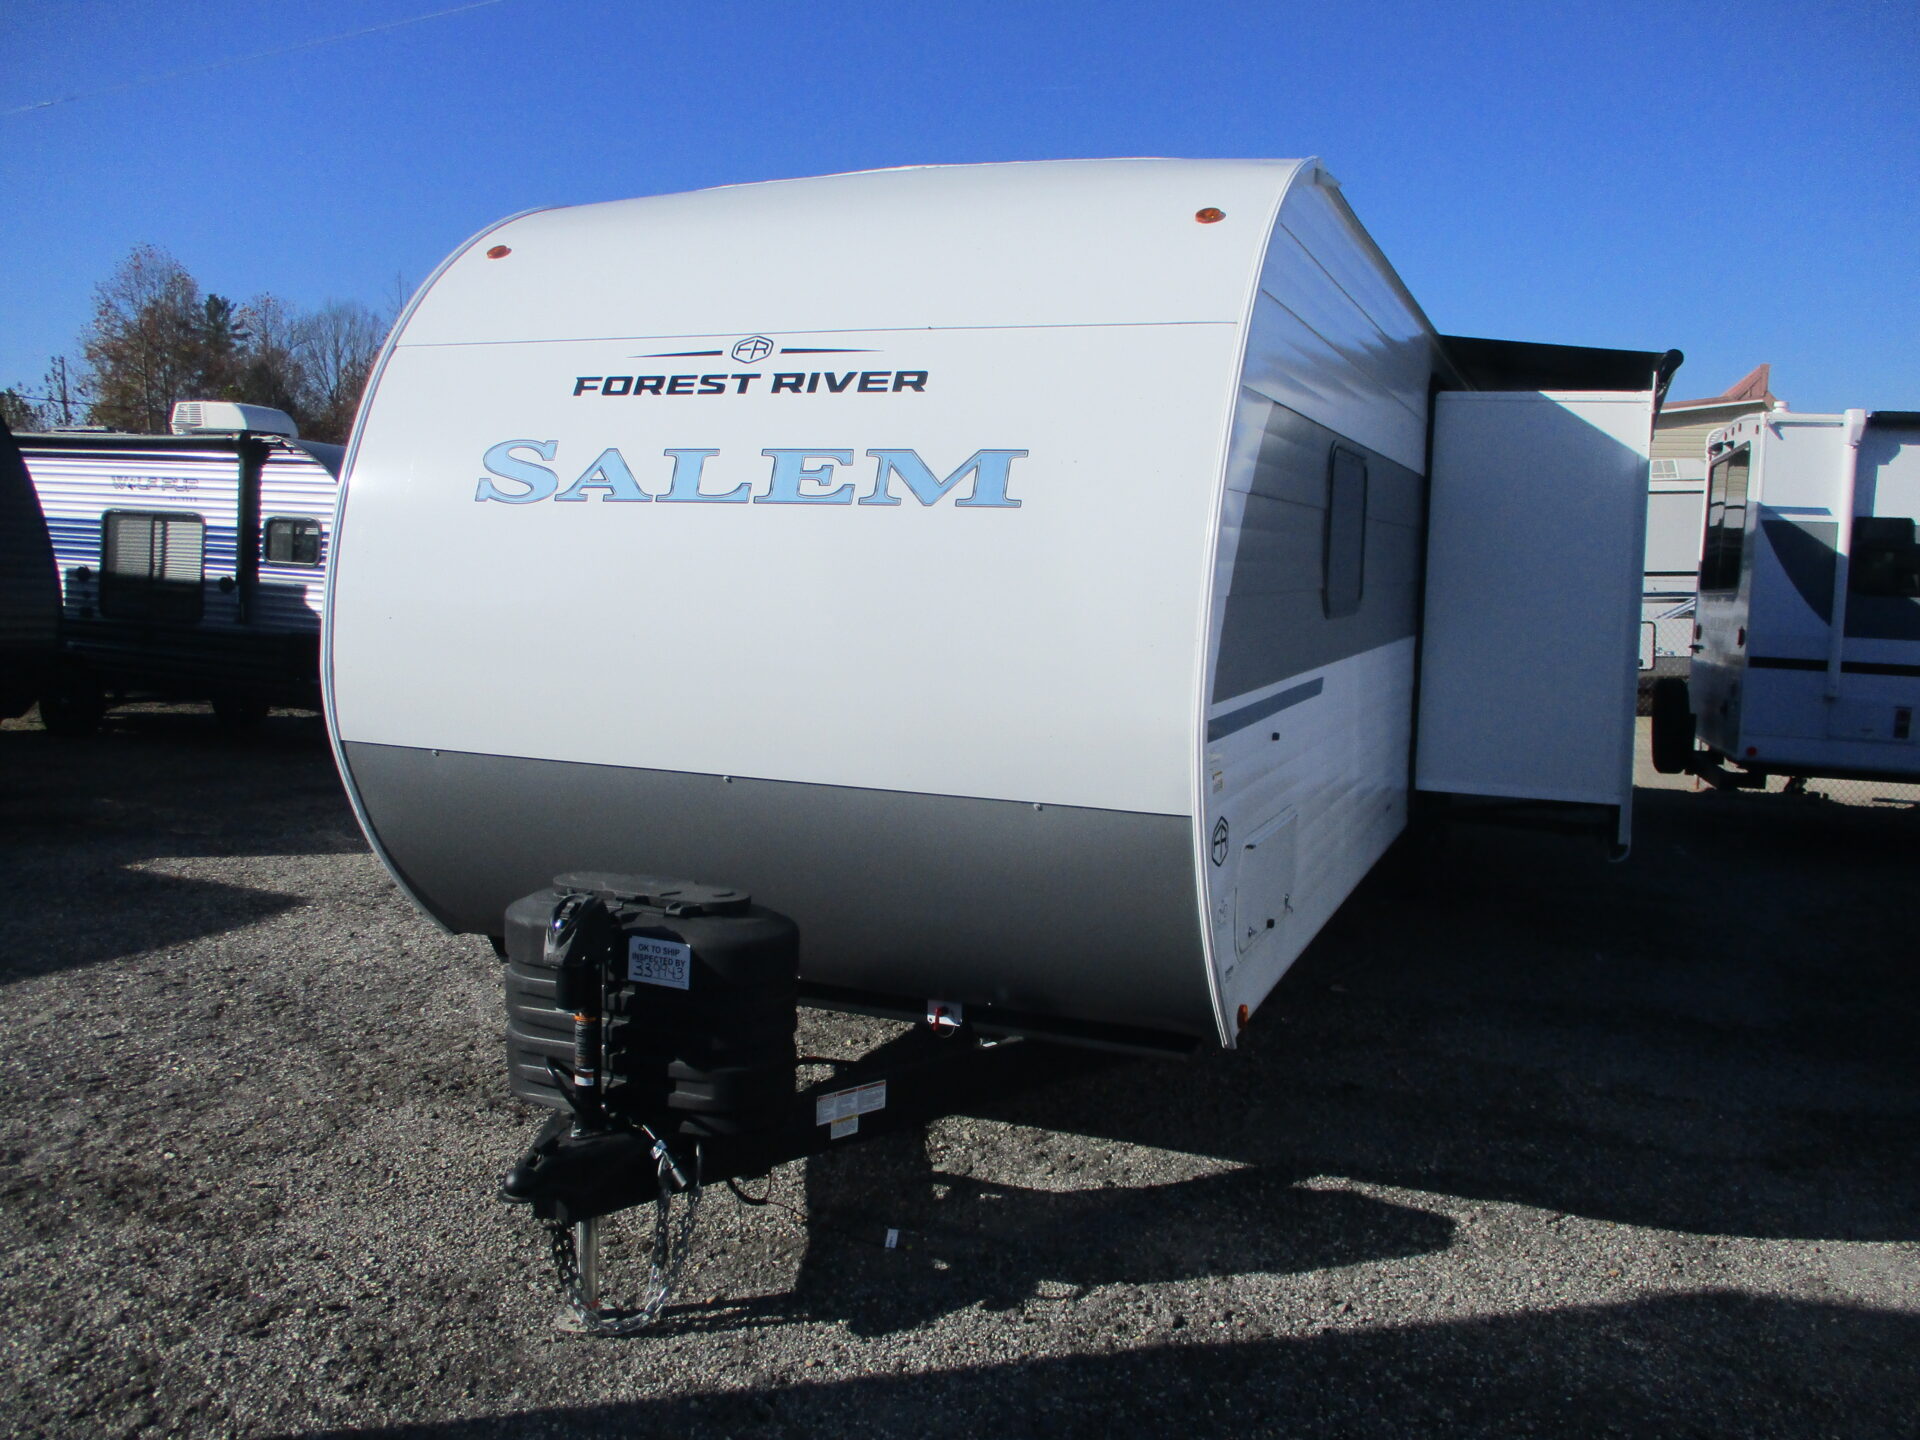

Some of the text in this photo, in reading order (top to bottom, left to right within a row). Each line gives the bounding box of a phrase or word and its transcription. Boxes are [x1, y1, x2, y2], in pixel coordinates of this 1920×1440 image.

[573, 370, 929, 397] FOREST RIVER
[475, 439, 1030, 508] SALEM
[632, 952, 686, 967] INSPECTED BY
[638, 943, 681, 957] OK TO SHIP
